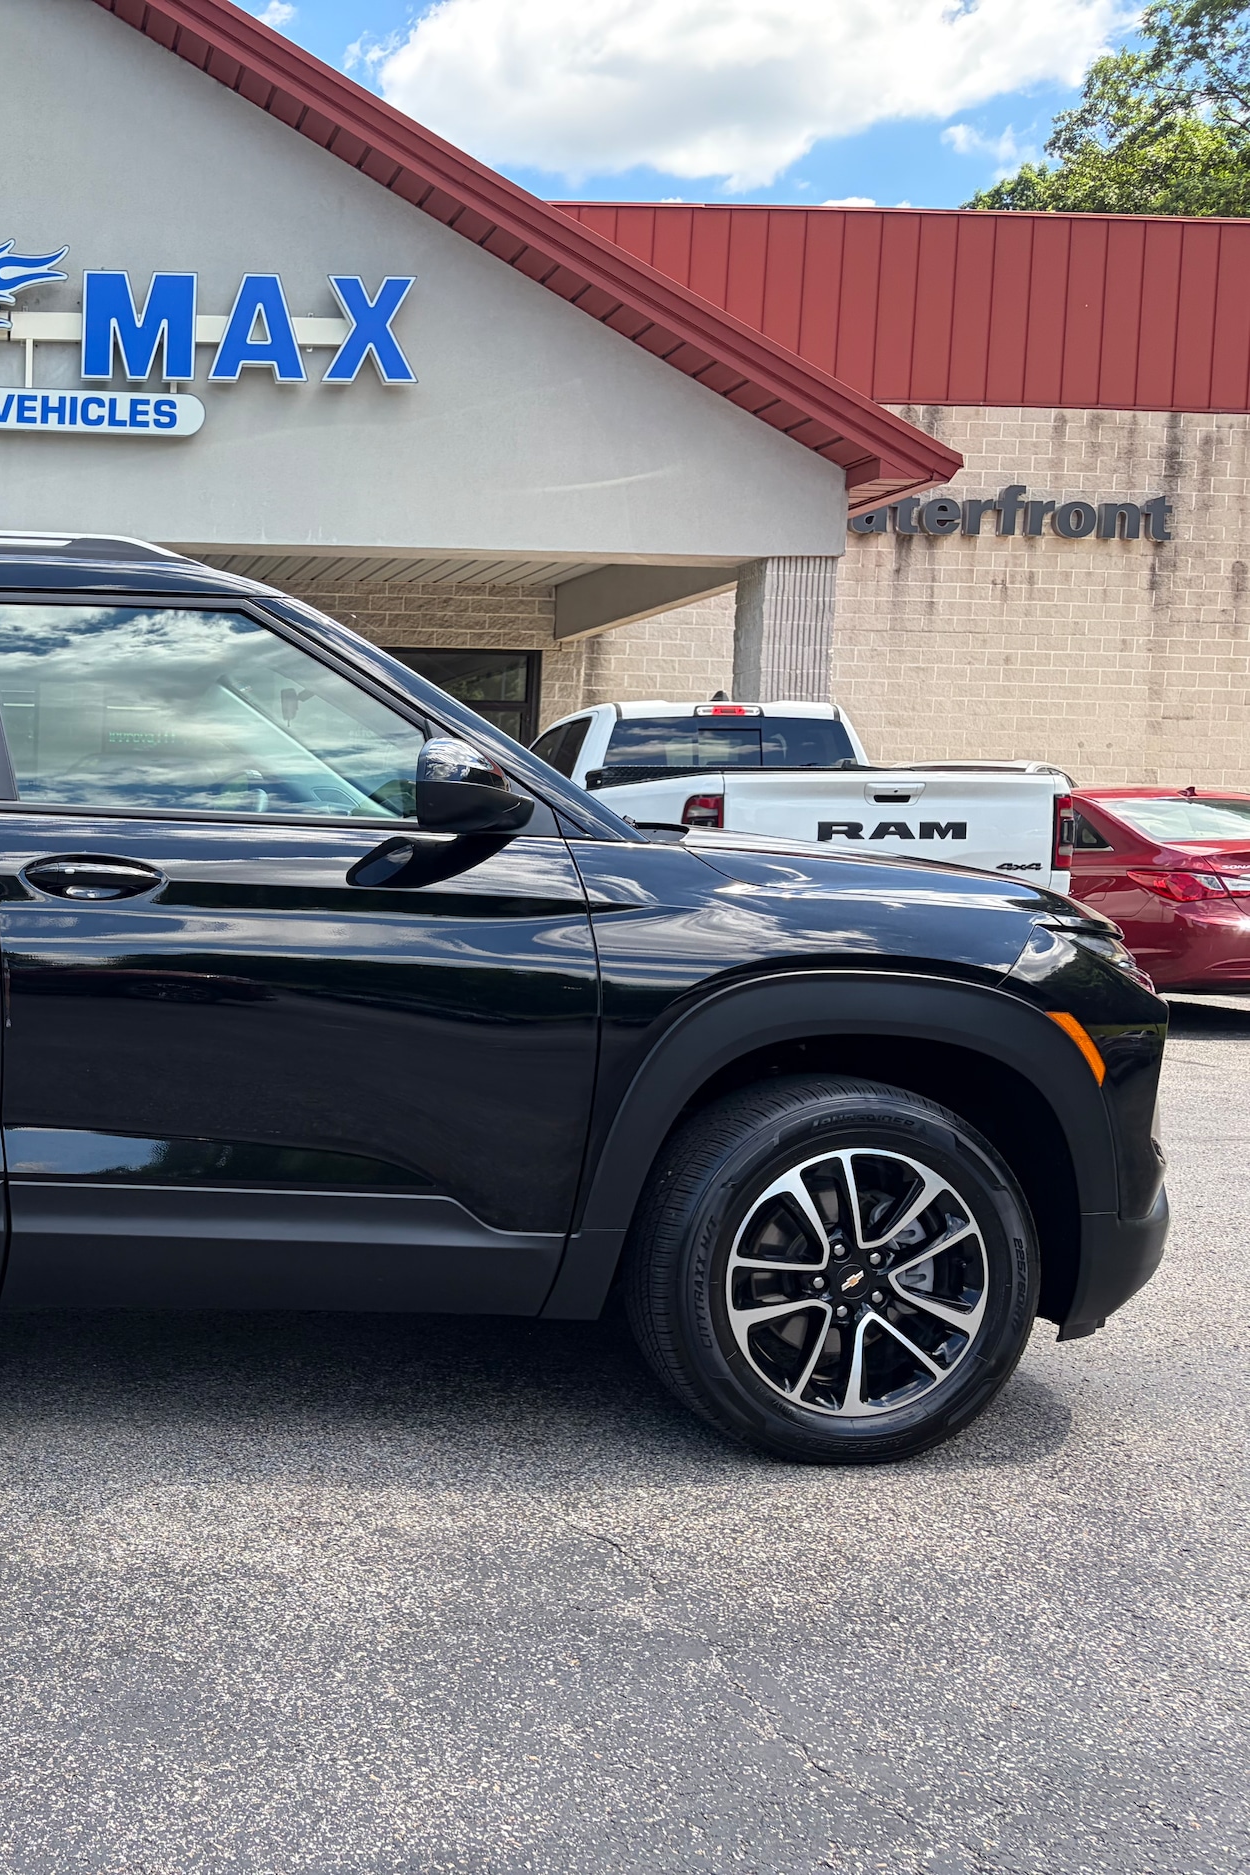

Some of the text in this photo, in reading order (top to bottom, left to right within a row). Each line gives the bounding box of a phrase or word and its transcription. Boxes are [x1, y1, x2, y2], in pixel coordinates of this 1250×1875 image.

[80, 269, 419, 385] MAX
[817, 821, 968, 842] RAM
[996, 862, 1044, 871] 4x4
[693, 1254, 713, 1349] CITYTRAXX
